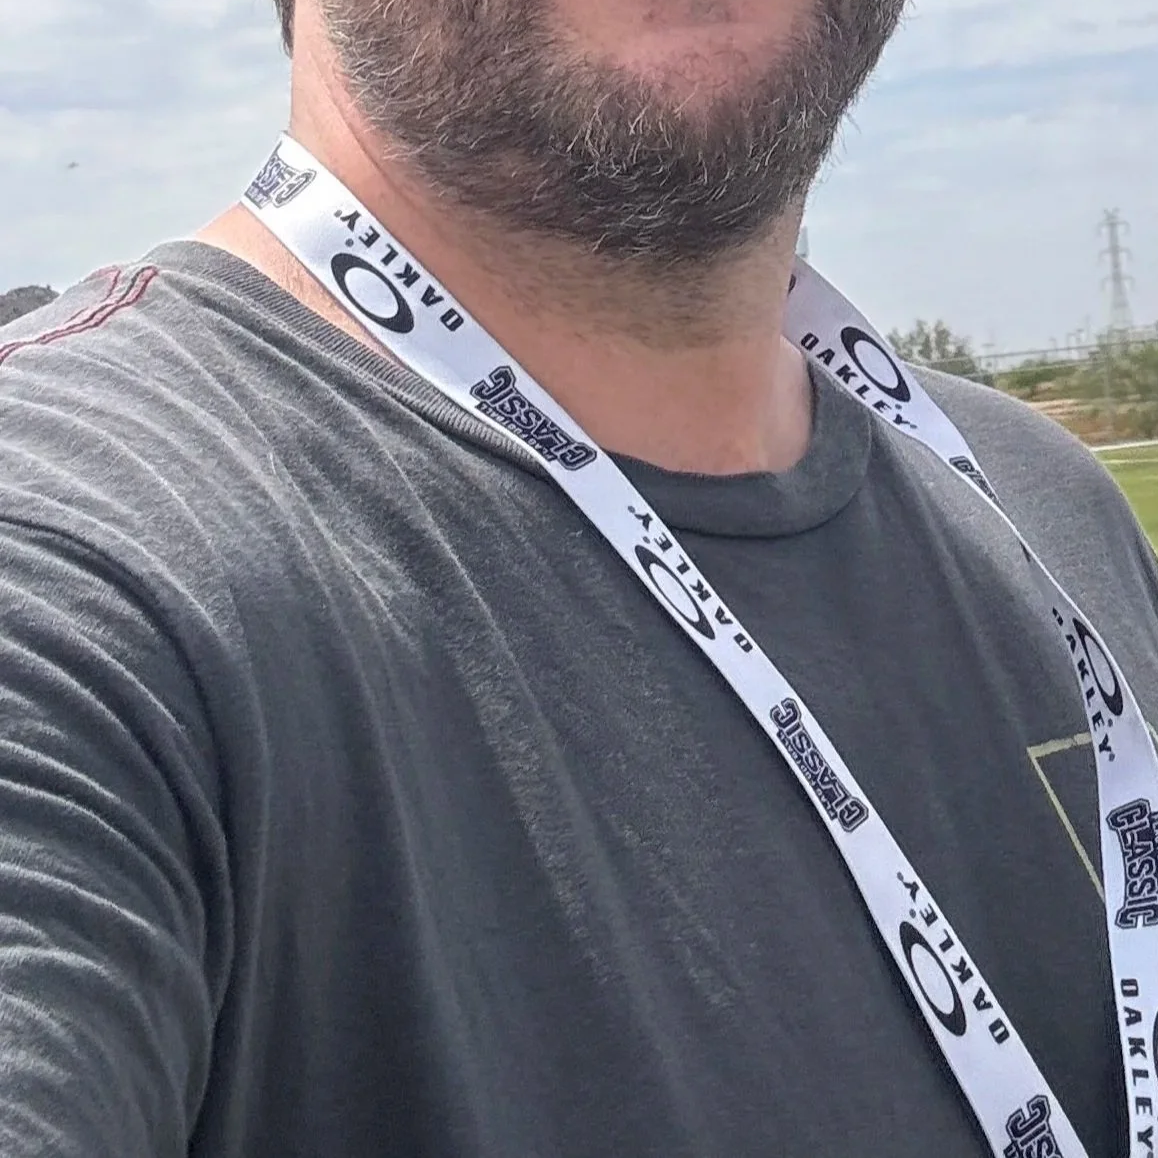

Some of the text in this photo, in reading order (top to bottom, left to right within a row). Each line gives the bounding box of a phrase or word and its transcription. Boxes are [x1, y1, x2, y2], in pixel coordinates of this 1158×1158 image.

[339, 209, 465, 333] OAKLEY
[469, 365, 598, 472] CLASSIC
[800, 332, 911, 428] OAKLEY
[631, 510, 754, 654] OAKLEY
[769, 697, 870, 834] CLASSIC
[901, 879, 1011, 1045] OAKLEY
[1119, 978, 1156, 1149] OAKLEY
